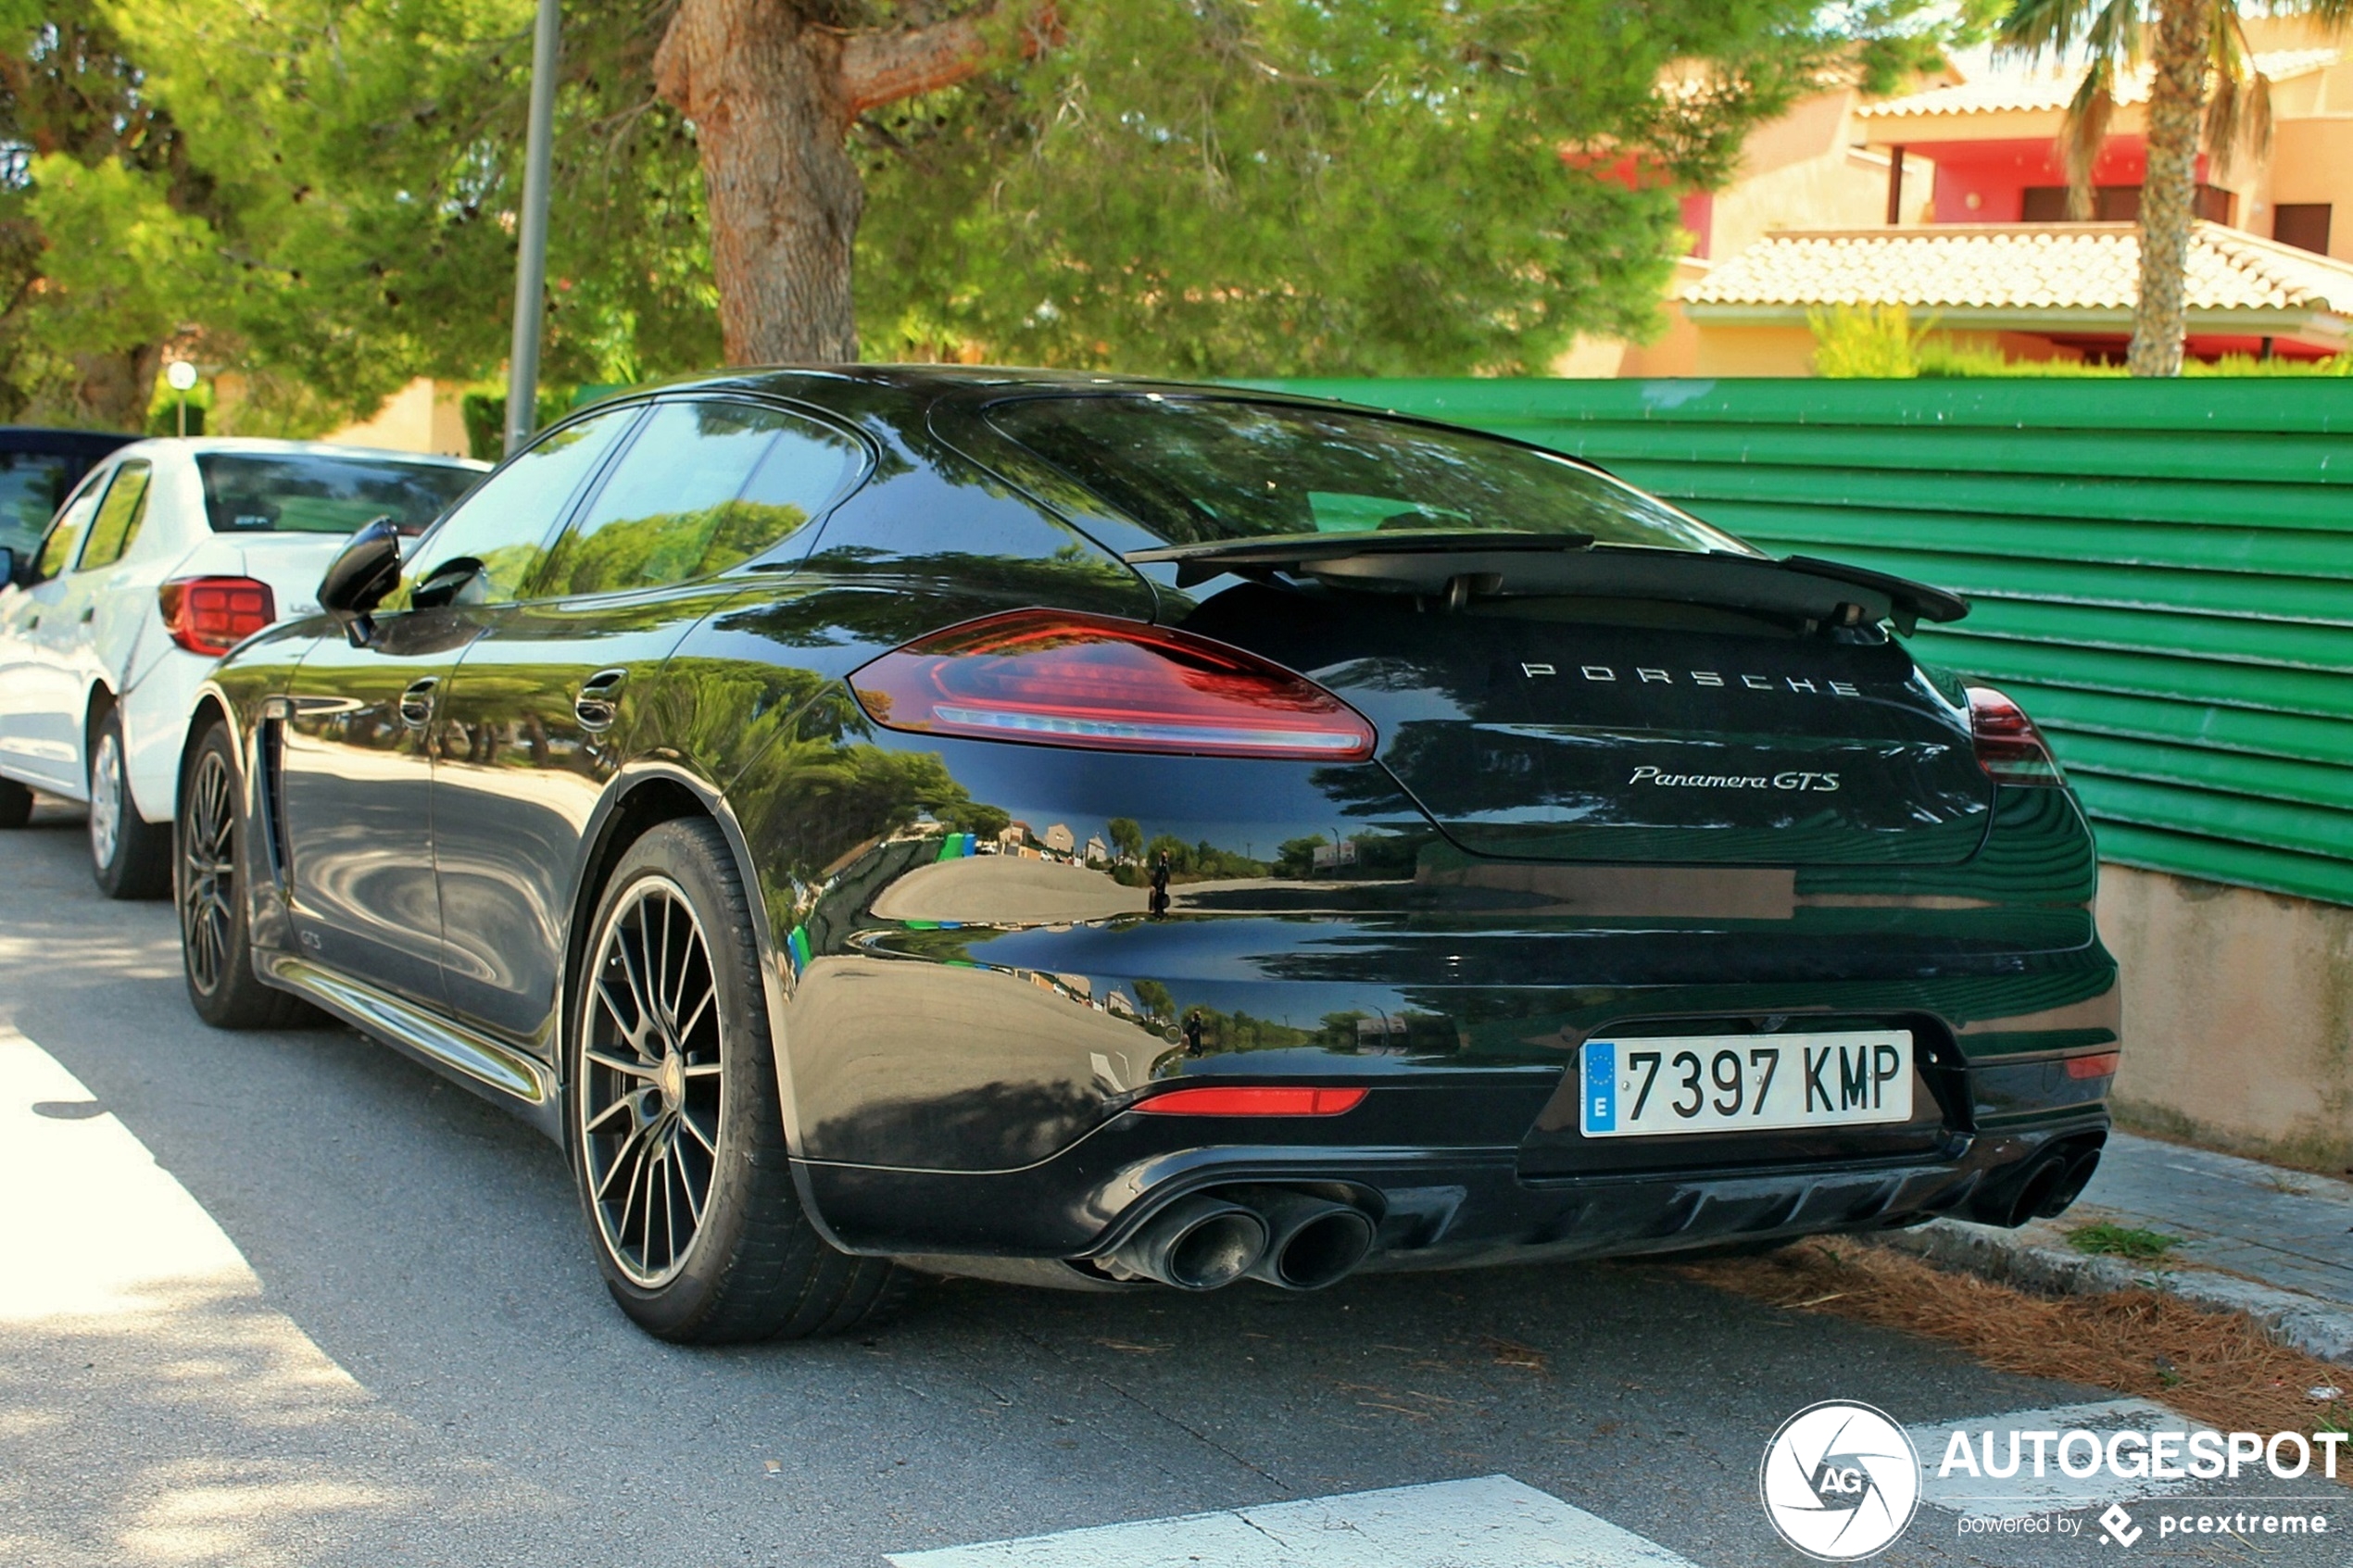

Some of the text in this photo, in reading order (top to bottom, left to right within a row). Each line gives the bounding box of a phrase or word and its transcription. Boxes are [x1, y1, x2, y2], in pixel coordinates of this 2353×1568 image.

[1521, 662, 1860, 697] PORSCHE
[1629, 765, 1840, 791] Panamera GTS
[1629, 1044, 1900, 1121] 7397 KMP
[1594, 1098, 1606, 1117] E
